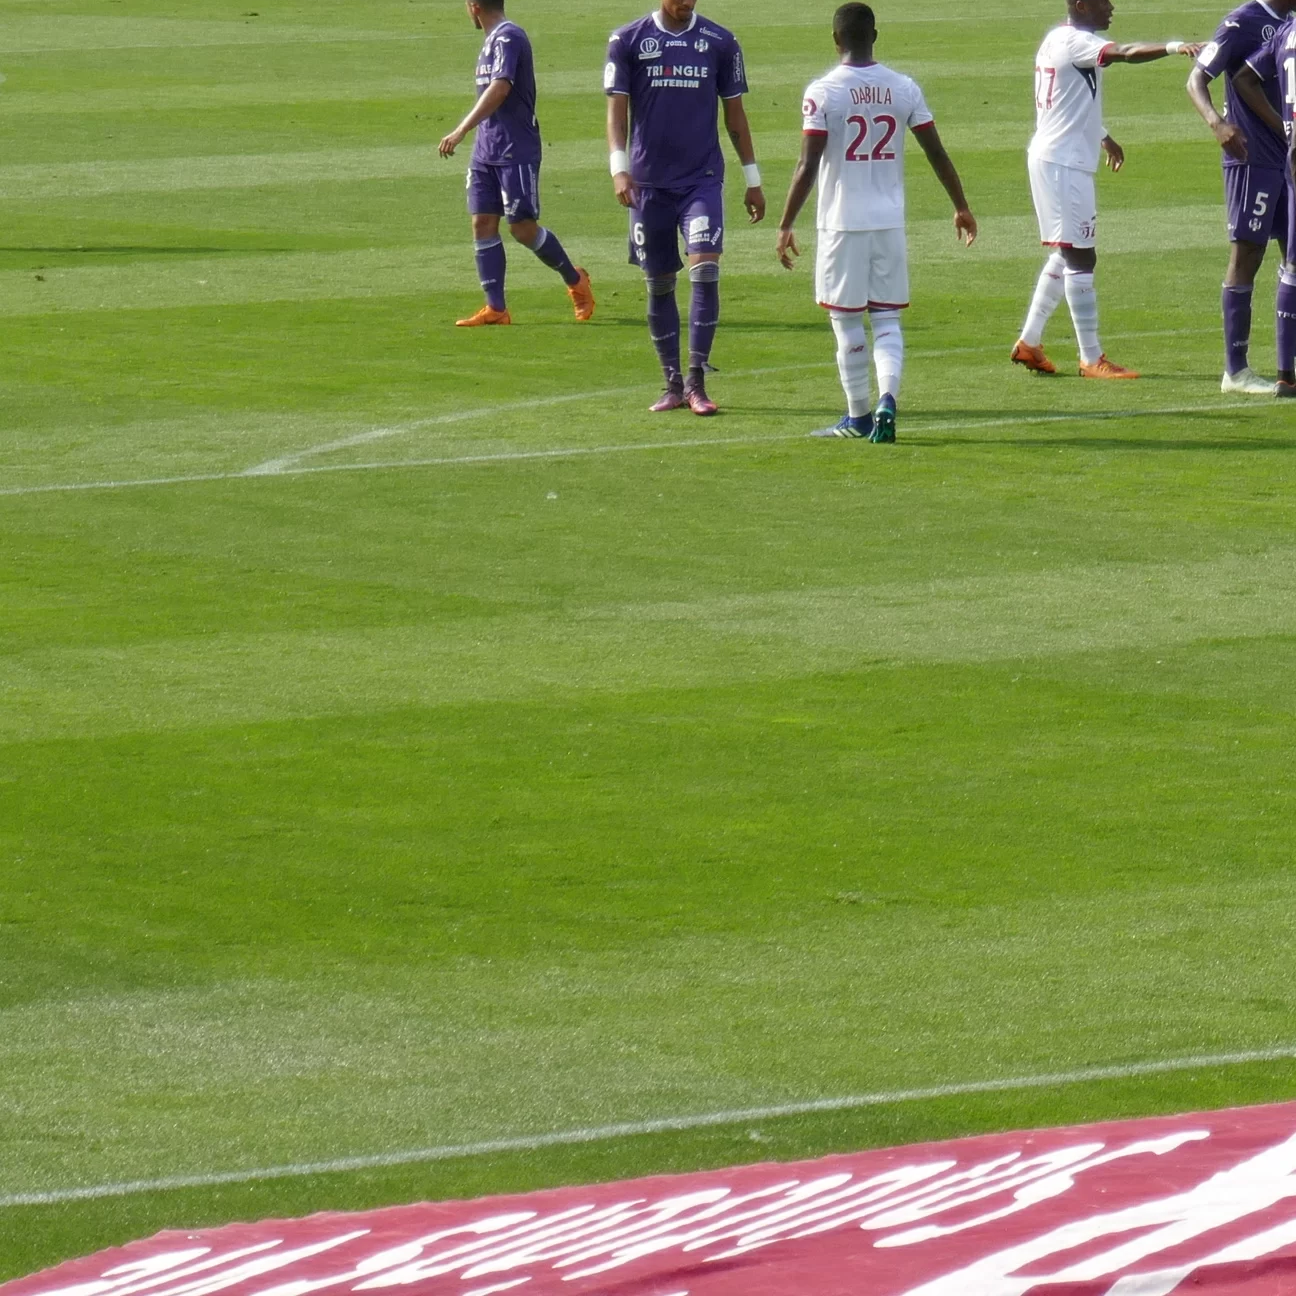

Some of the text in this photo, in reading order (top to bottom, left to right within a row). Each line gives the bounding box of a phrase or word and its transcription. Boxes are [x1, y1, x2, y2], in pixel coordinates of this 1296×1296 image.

[849, 86, 892, 105] DABILA
[845, 114, 896, 161] 22
[1252, 191, 1269, 216] 5
[633, 222, 645, 246] 6
